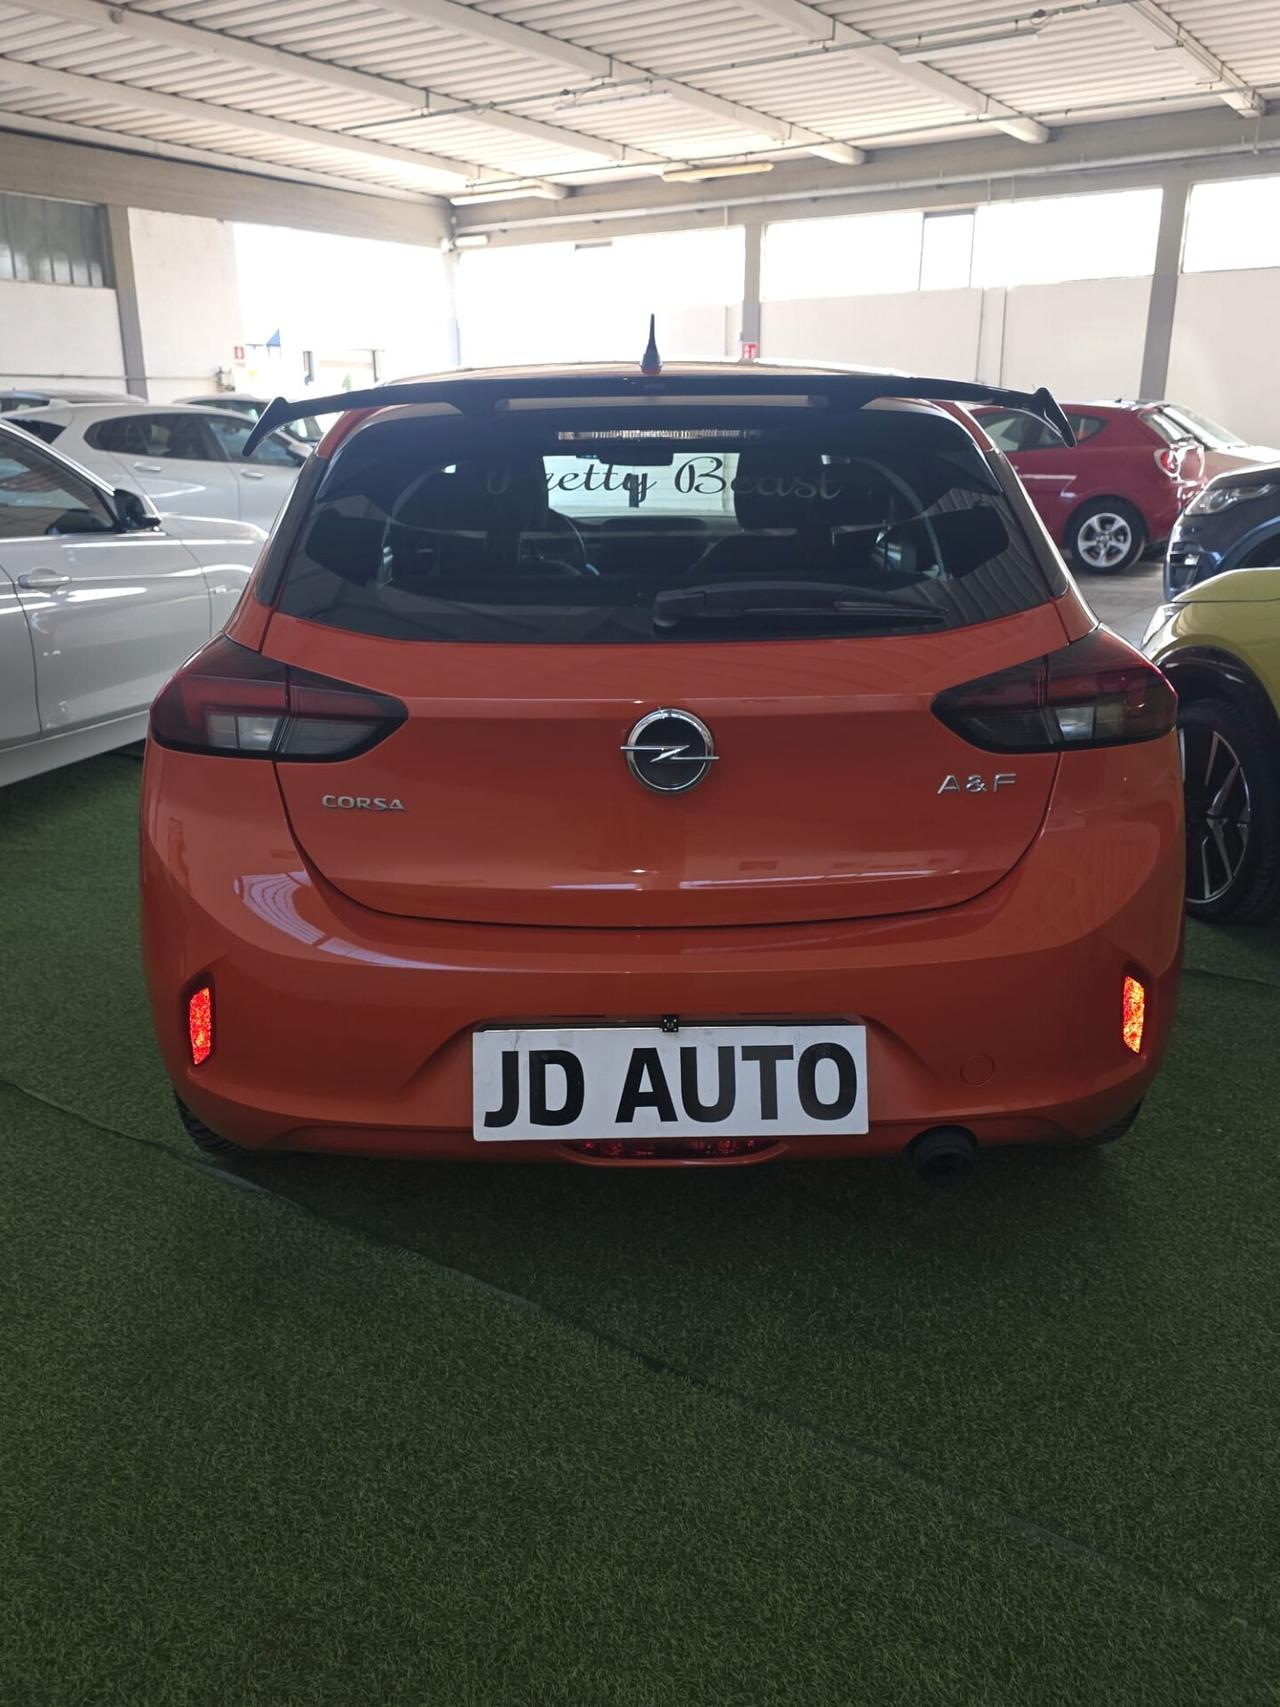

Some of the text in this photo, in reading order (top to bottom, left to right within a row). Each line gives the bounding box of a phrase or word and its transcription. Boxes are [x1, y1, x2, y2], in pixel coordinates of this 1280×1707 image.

[674, 455, 841, 499] Beast
[937, 773, 1017, 794] A&F
[322, 794, 405, 811] CORSA
[483, 1042, 858, 1128] JD AUTO
